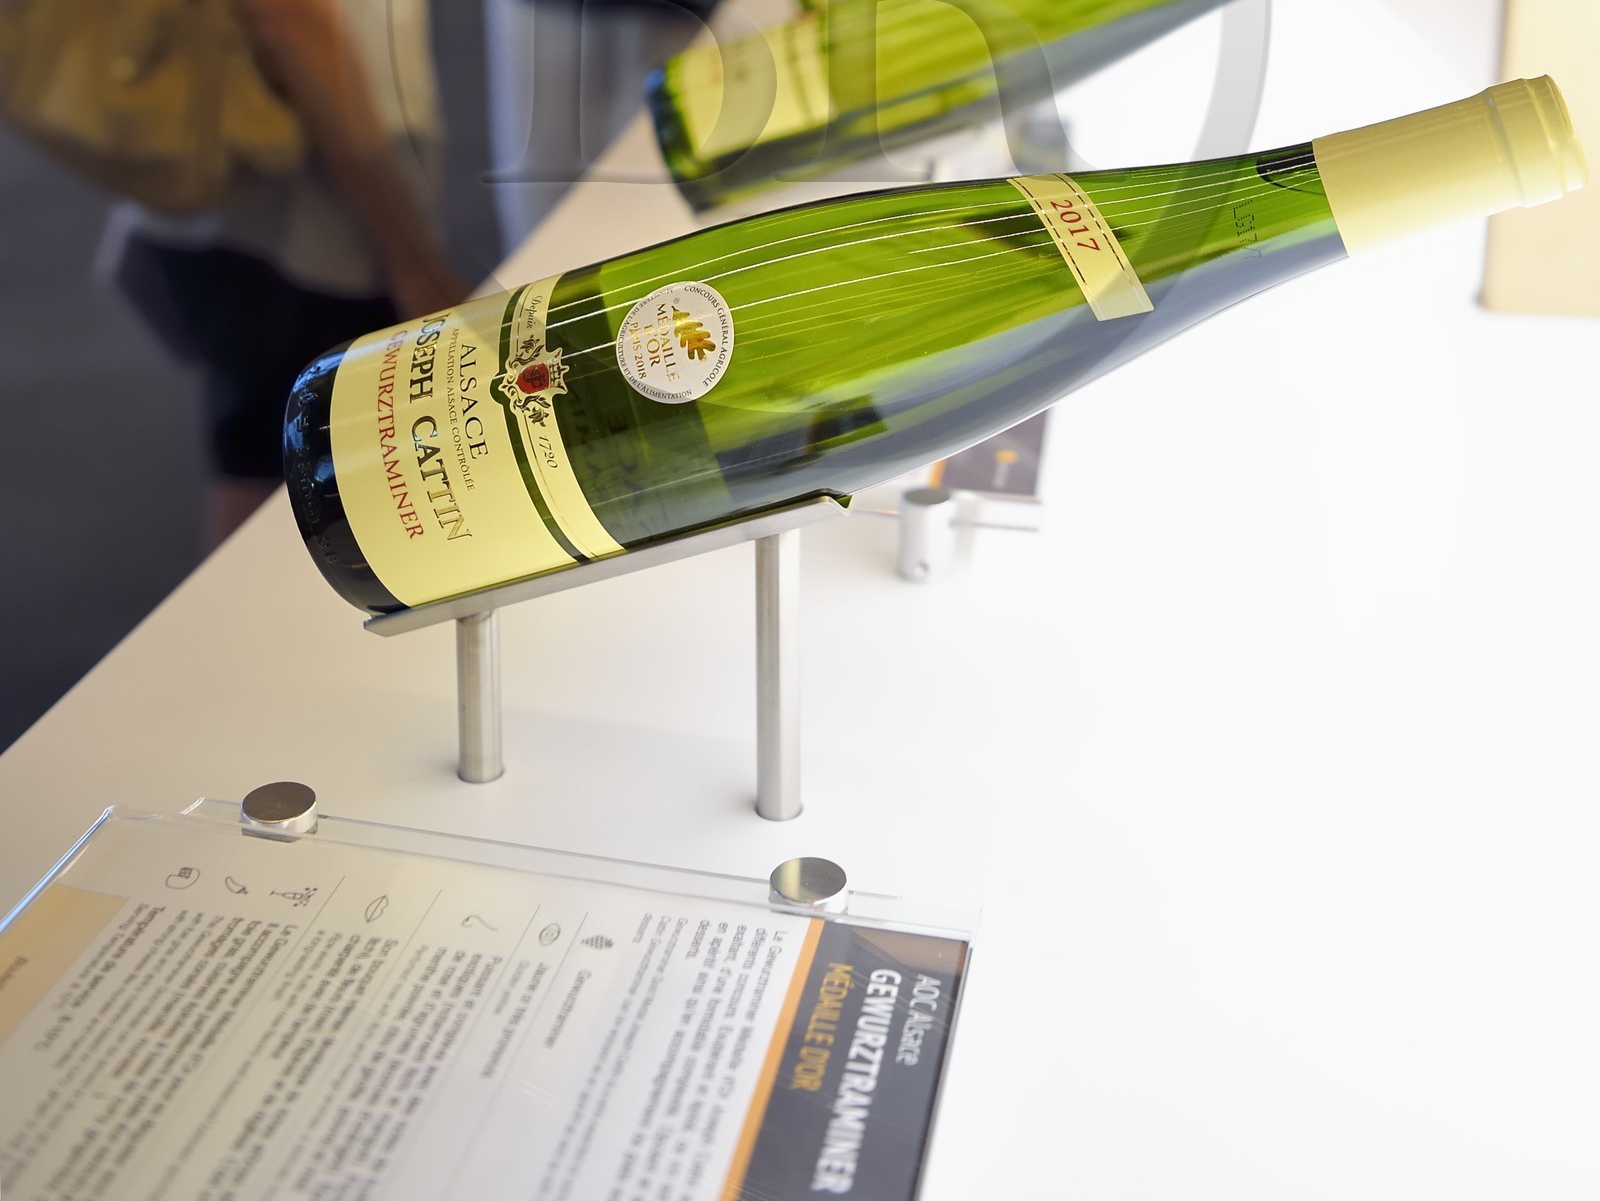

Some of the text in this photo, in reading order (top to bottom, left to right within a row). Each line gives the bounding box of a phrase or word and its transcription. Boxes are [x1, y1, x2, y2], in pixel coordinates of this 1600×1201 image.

[1050, 199, 1101, 251] 2017
[526, 295, 558, 469] Depuis 1720
[624, 367, 631, 376] ET
[629, 377, 638, 387] DE
[634, 354, 647, 379] 2018
[644, 324, 661, 367] D'OR
[656, 302, 680, 381] MÉDAILLE
[684, 285, 729, 387] CONCOURS GÉNÉRAL AGRICOLE
[377, 330, 424, 540] GEWURZTRAMINER
[410, 312, 473, 541] JOSEPH CATTIN
[447, 328, 475, 491] APPELLATION ALSACE CONTRÔLÉE
[460, 344, 488, 459] ALSACE
[896, 974, 940, 1064] AOC Alsace
[811, 968, 902, 1193] GEWURZTRAMINER
